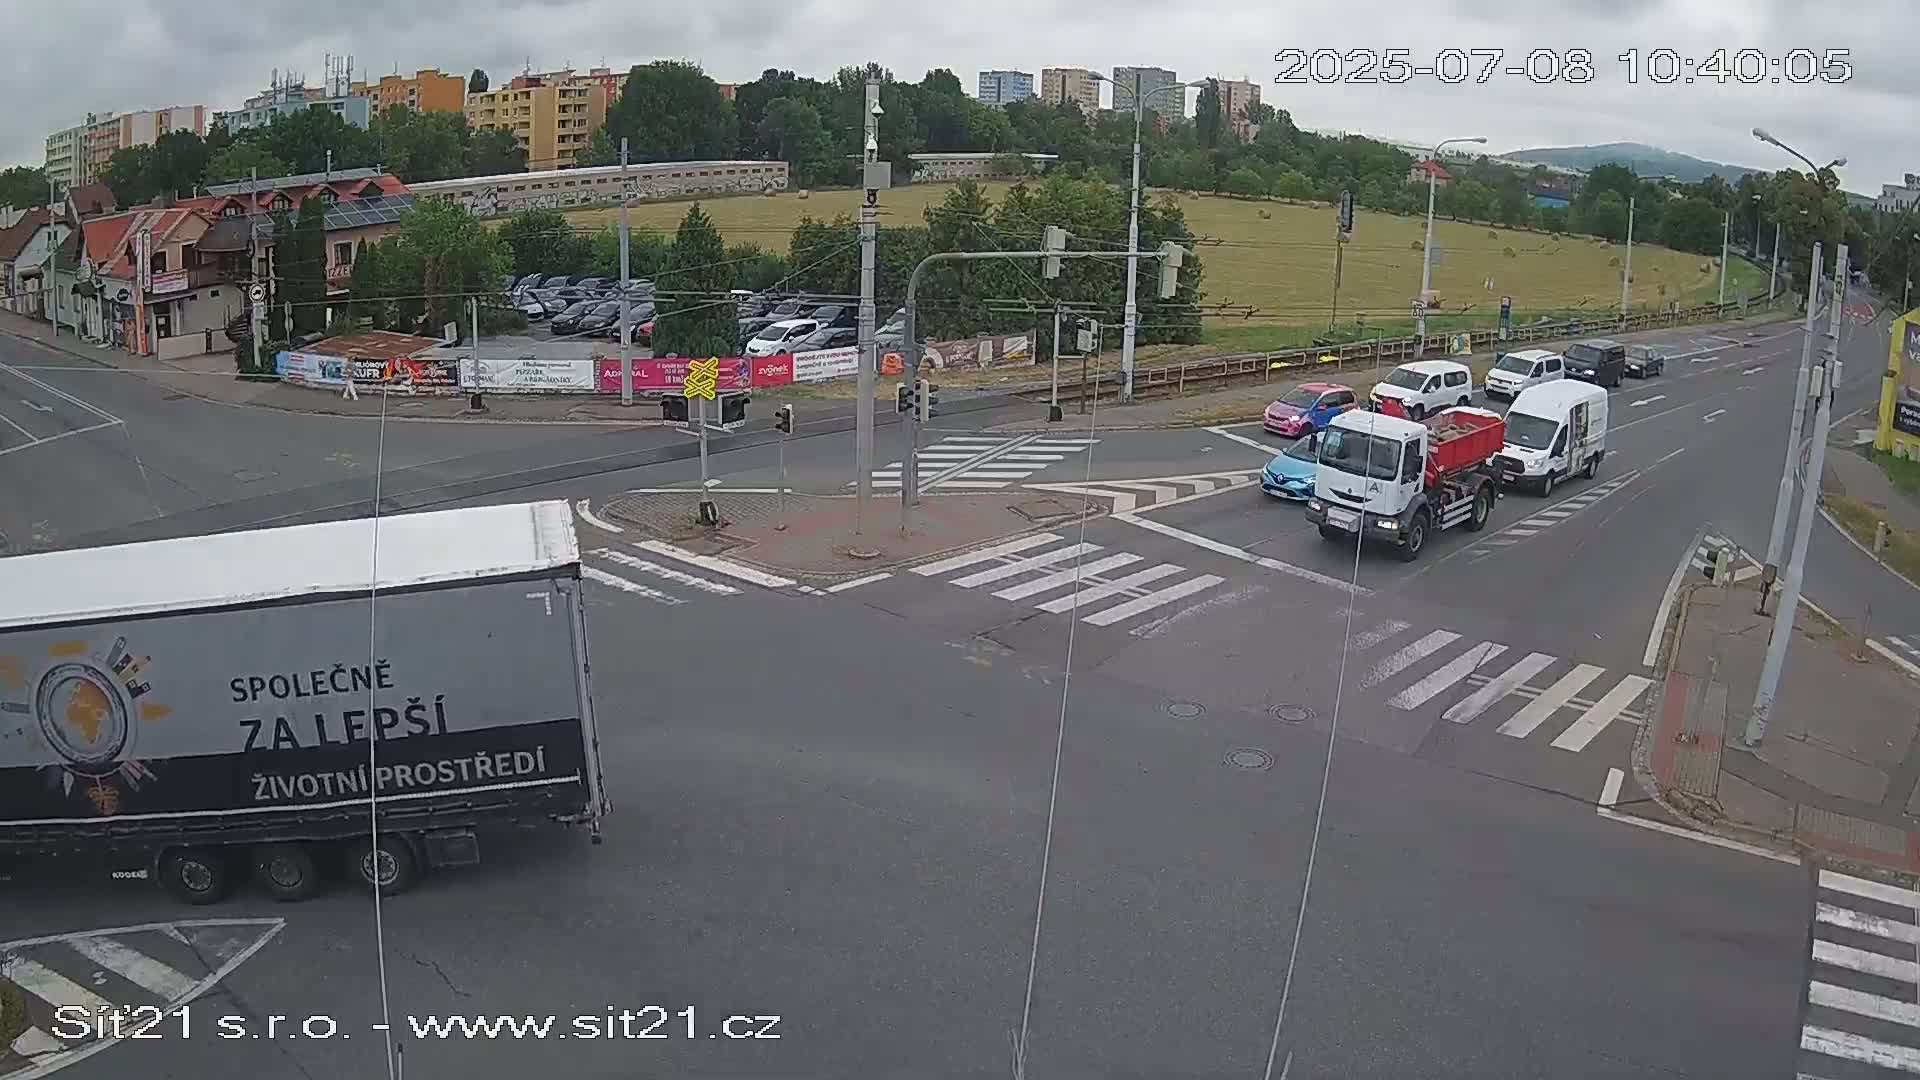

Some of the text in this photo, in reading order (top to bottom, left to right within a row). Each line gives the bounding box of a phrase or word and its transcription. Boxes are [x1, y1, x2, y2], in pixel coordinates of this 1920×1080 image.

[604, 369, 648, 377] ADMRAL
[230, 659, 395, 702] SPOLEČNĚ
[238, 694, 448, 754] ZA LEPŠÍ
[252, 746, 547, 801] ŽIVOTNÍ PROSTŘEDÍ
